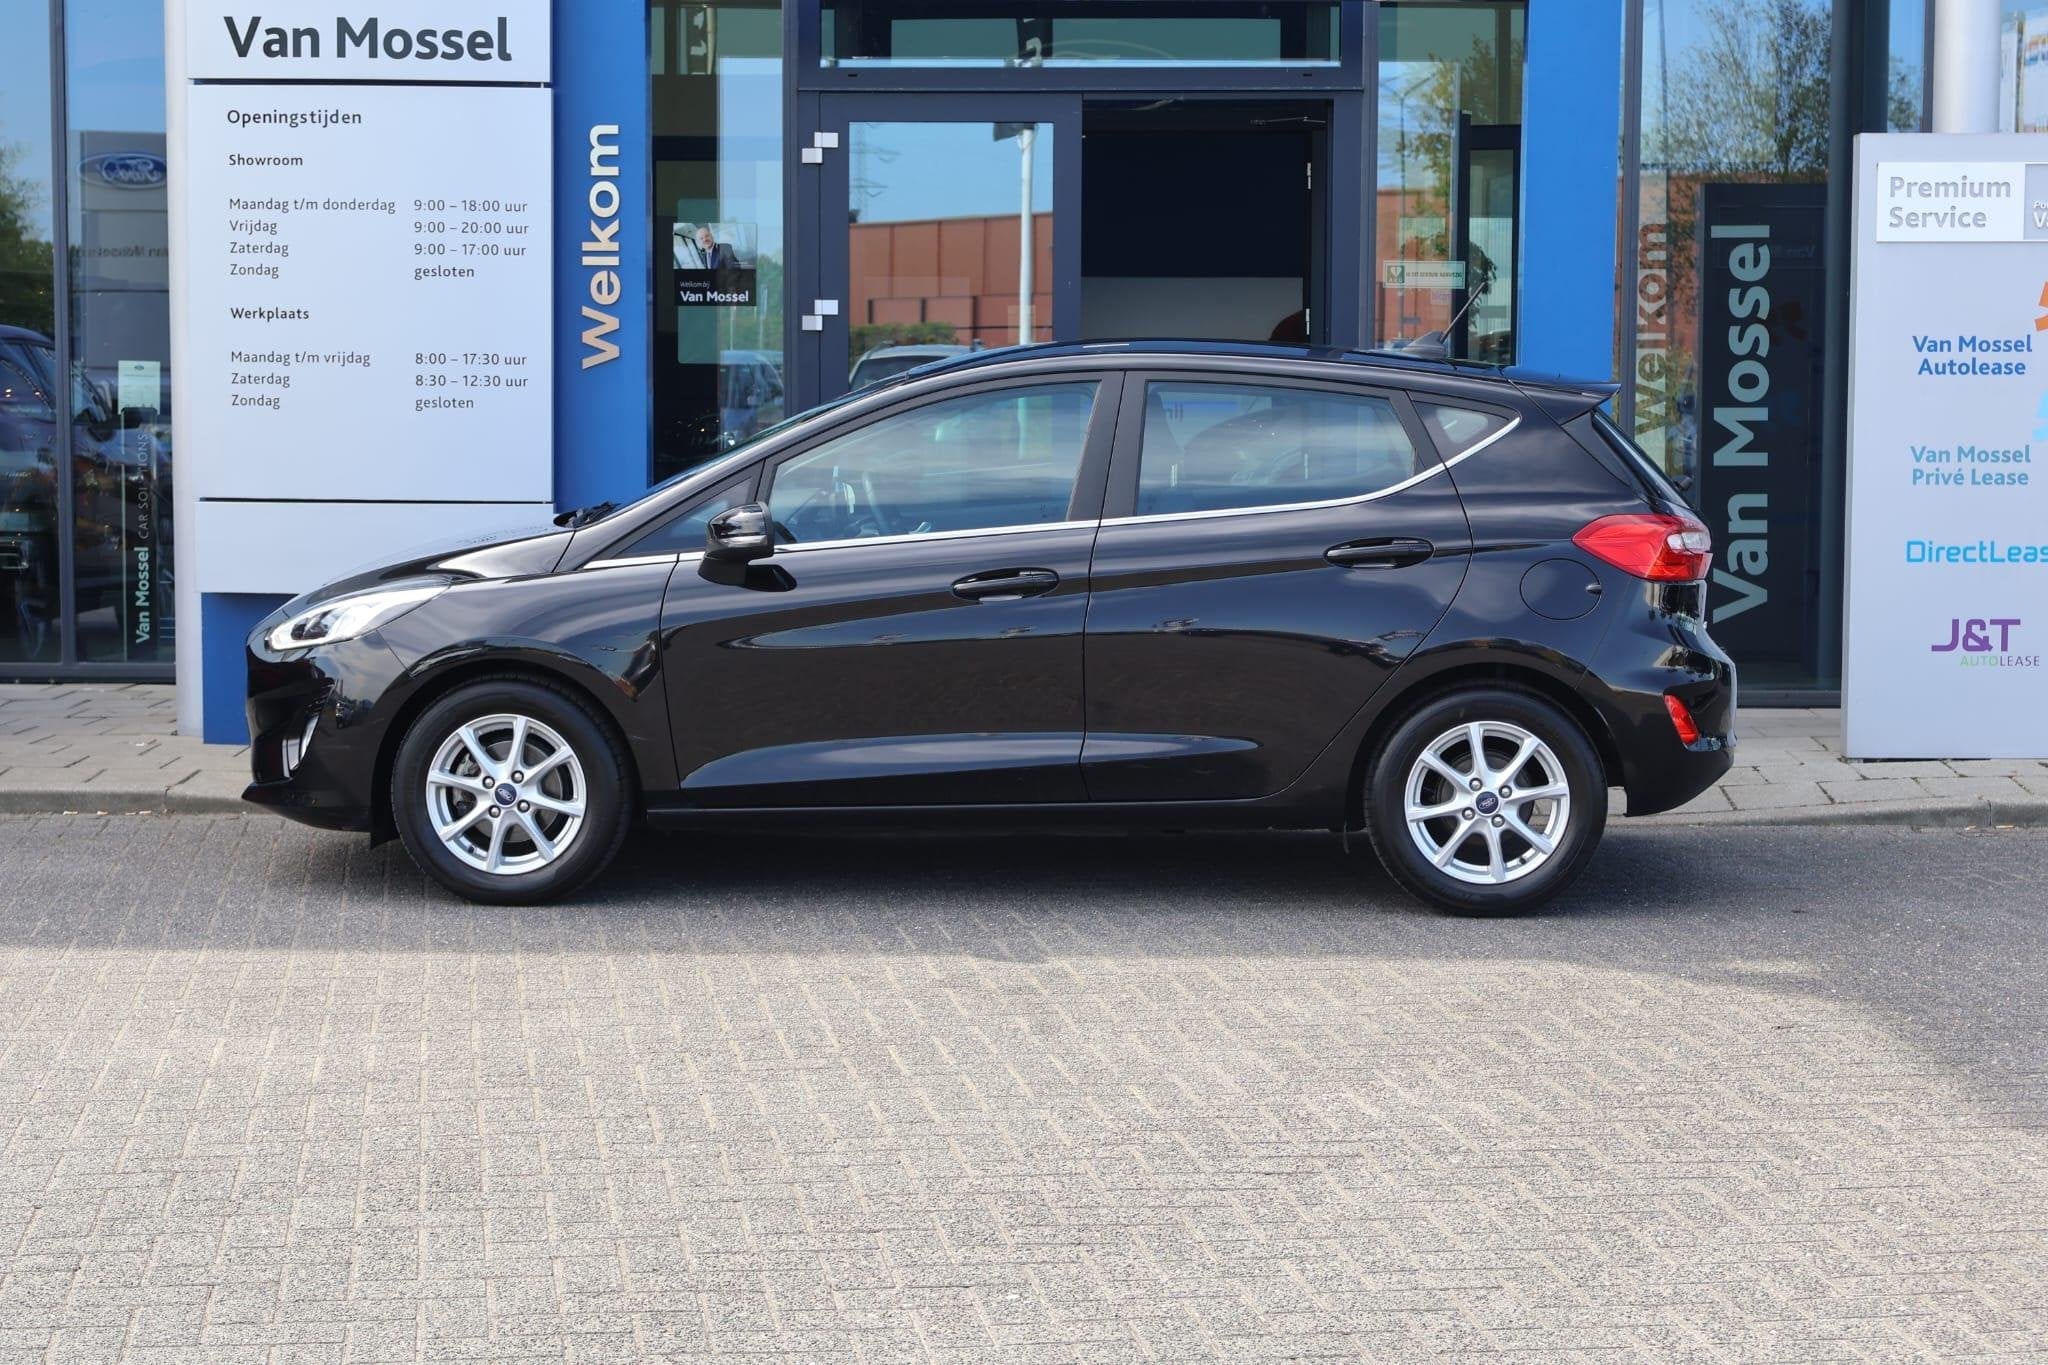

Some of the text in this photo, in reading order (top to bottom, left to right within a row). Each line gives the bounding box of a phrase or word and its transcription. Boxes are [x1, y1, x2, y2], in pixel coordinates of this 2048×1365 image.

[224, 16, 512, 61] Van Mossel
[228, 109, 361, 128] Openingstijden
[229, 154, 302, 165] Showroom
[1889, 175, 2011, 198] Premium
[230, 198, 395, 214] Maandag t/m donderdag
[414, 200, 445, 211] 9:00
[462, 200, 500, 211] 18:00
[505, 204, 527, 212] uur
[1889, 205, 1987, 228] Service
[230, 220, 277, 235] Vrijdag
[415, 222, 445, 233] 9:00
[462, 222, 501, 233] 20:00
[230, 242, 288, 257] Zaterdag
[415, 244, 445, 255] 9:00
[462, 244, 498, 255] 17:00
[504, 247, 526, 255] uur
[581, 124, 621, 369] Welkom
[230, 264, 279, 279] Zondag
[415, 265, 474, 280] gesloten
[680, 291, 749, 302] Van Mossel
[231, 307, 309, 322] Werkplaats
[1635, 222, 1667, 440] Welkom
[1912, 334, 2032, 352] Van Mossel
[232, 351, 370, 367] Maandag t/m vrijdag
[416, 353, 446, 364] 8:00
[463, 353, 499, 365] 17:30
[505, 357, 526, 365] uur
[1918, 357, 2025, 375] Autolease
[232, 373, 290, 388] Zaterdag
[416, 375, 446, 386] 8:30
[463, 375, 500, 387] 12:30
[506, 379, 528, 387] uur
[232, 394, 280, 409] Zondag
[416, 396, 473, 411] gesloten
[1711, 225, 1771, 624] Van Mossel
[1910, 445, 2031, 463] Van Mossel
[1913, 468, 2028, 485] Privé Lease
[133, 433, 151, 644] Van Mossel CAR SOLTIONS
[1931, 619, 2021, 652] J&T
[1960, 655, 2040, 666] AUTOLEASE
